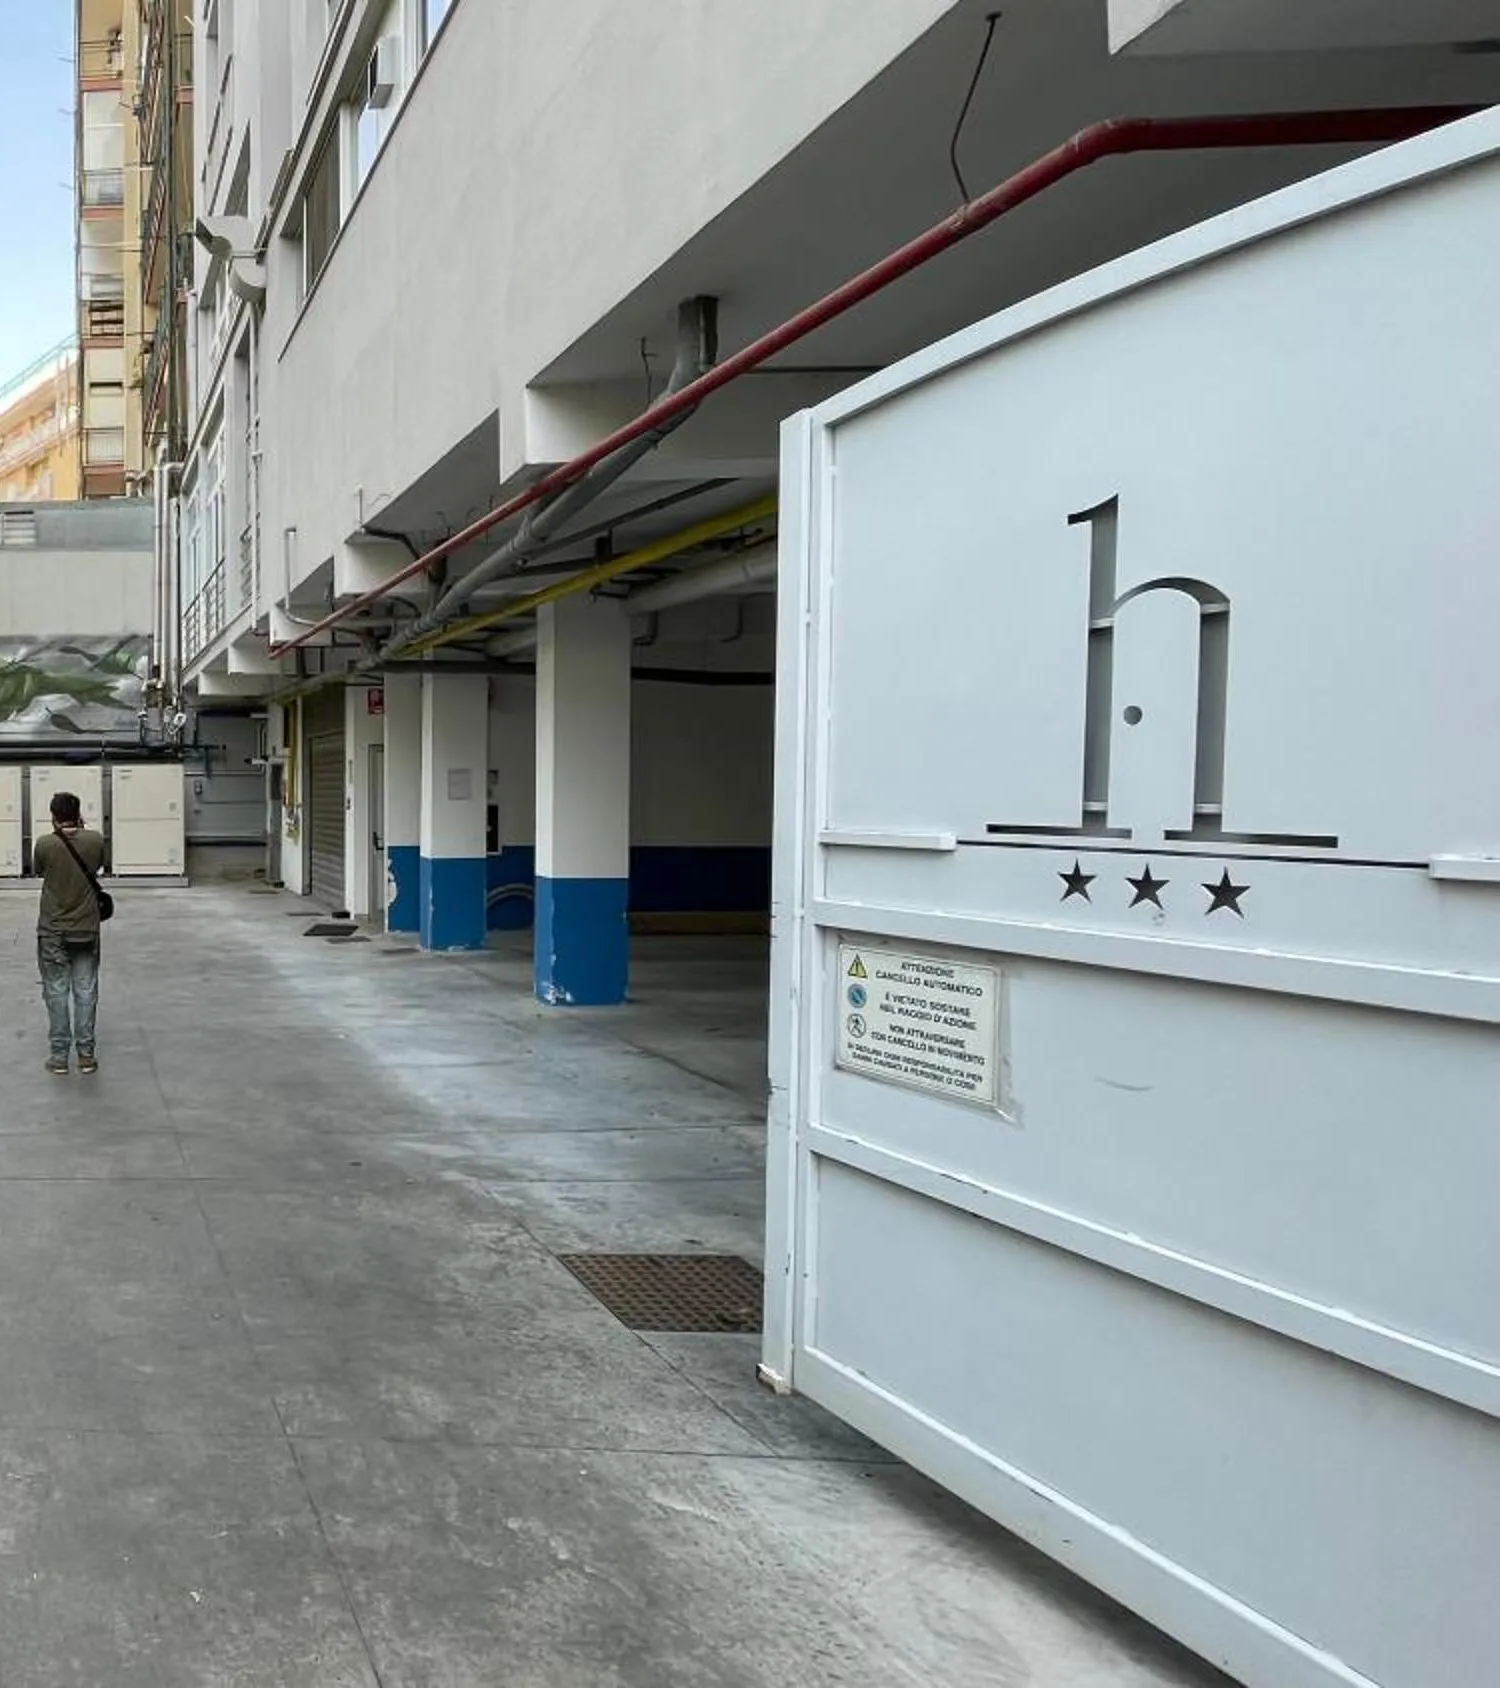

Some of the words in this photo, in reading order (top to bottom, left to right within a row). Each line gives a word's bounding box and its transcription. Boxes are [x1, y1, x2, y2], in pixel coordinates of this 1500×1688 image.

[902, 962, 955, 978] ATTENZIONE
[876, 969, 921, 986] CANCELLO
[924, 979, 983, 996] AUTOMATICO
[880, 1003, 895, 1014] NEL
[898, 1007, 932, 1021] RAGGIO
[892, 994, 926, 1008] VIETATO
[929, 1001, 971, 1017] SOSTARE
[889, 1024, 904, 1034] NON
[907, 1028, 965, 1048] ATTRAVERSARE
[888, 1036, 926, 1051] CANCELLO
[937, 1047, 985, 1065] MOVIMENTO
[966, 1072, 983, 1082] PER
